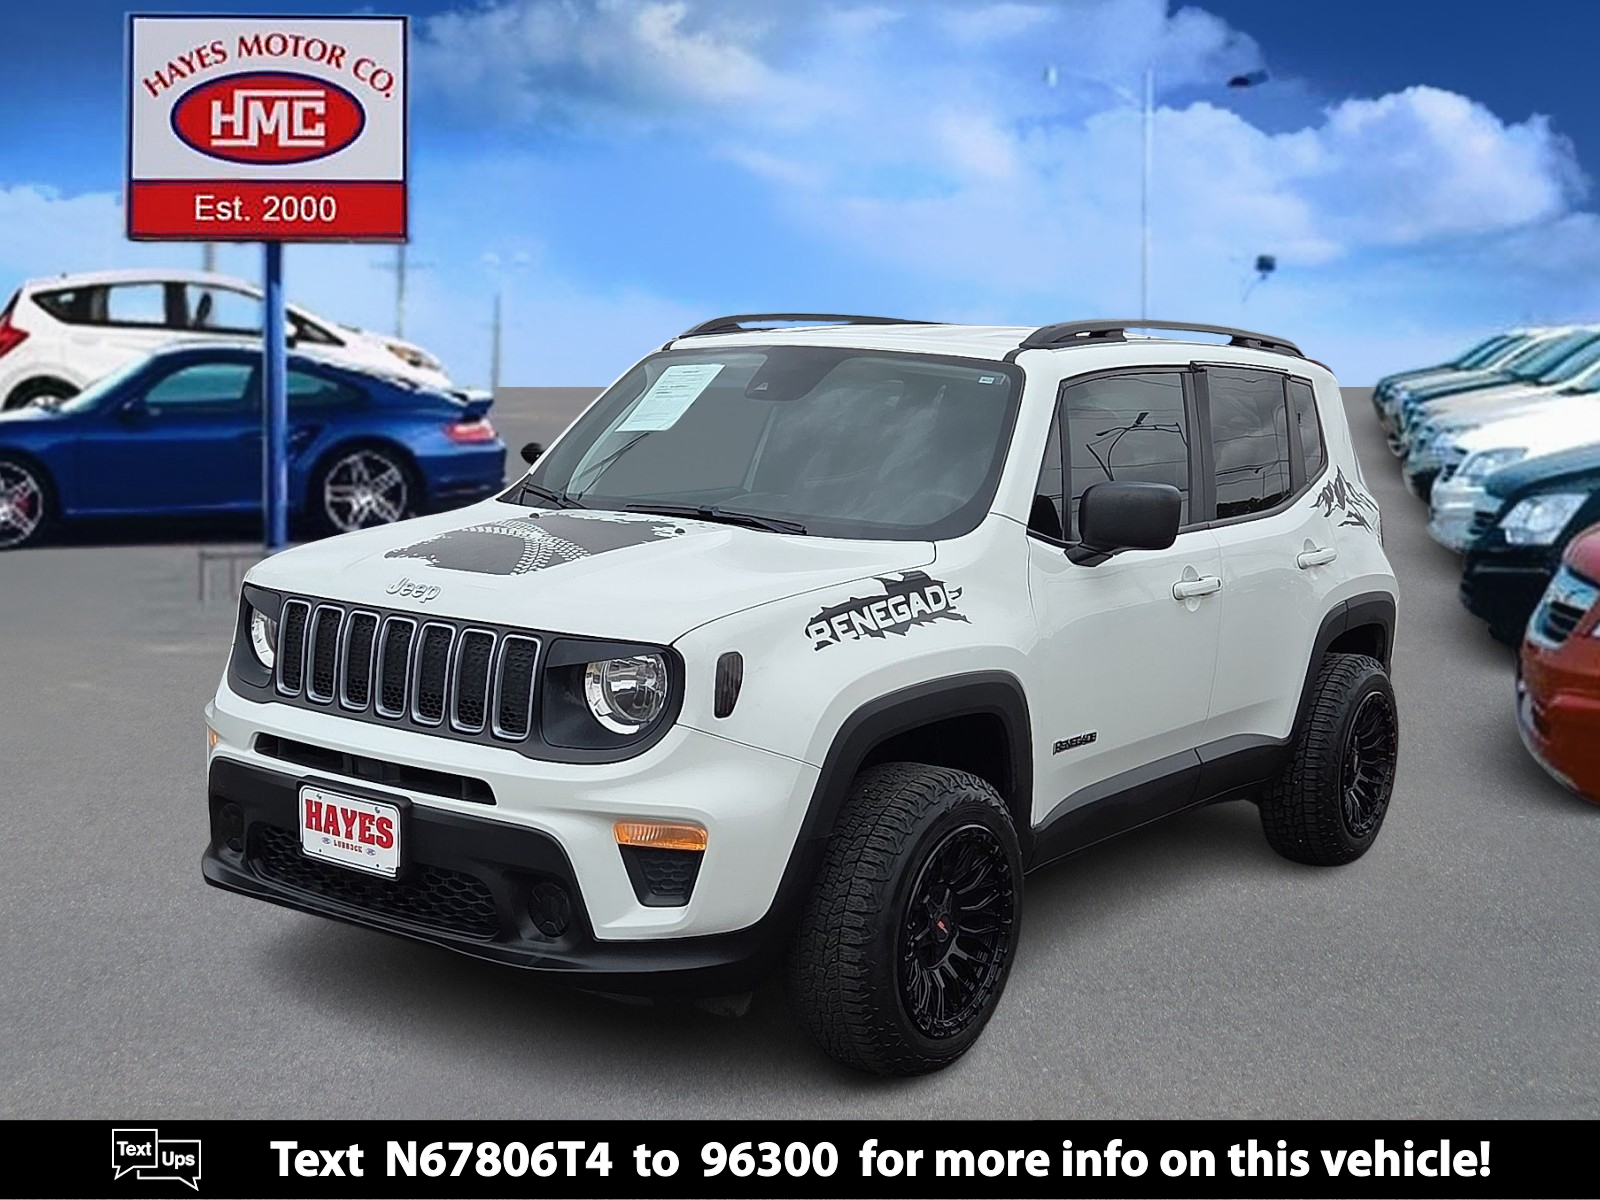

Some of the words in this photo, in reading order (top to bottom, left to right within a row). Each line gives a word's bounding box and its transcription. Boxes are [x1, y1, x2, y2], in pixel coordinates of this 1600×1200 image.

[142, 40, 228, 98] HAYES
[237, 33, 346, 70] MOTOR
[352, 57, 395, 99] CO.
[210, 89, 326, 147] HMC
[195, 195, 250, 221] Est.
[262, 195, 337, 222] 2000
[385, 577, 441, 604] Jeep
[805, 584, 962, 650] RENEGADE
[305, 798, 394, 849] HAYES
